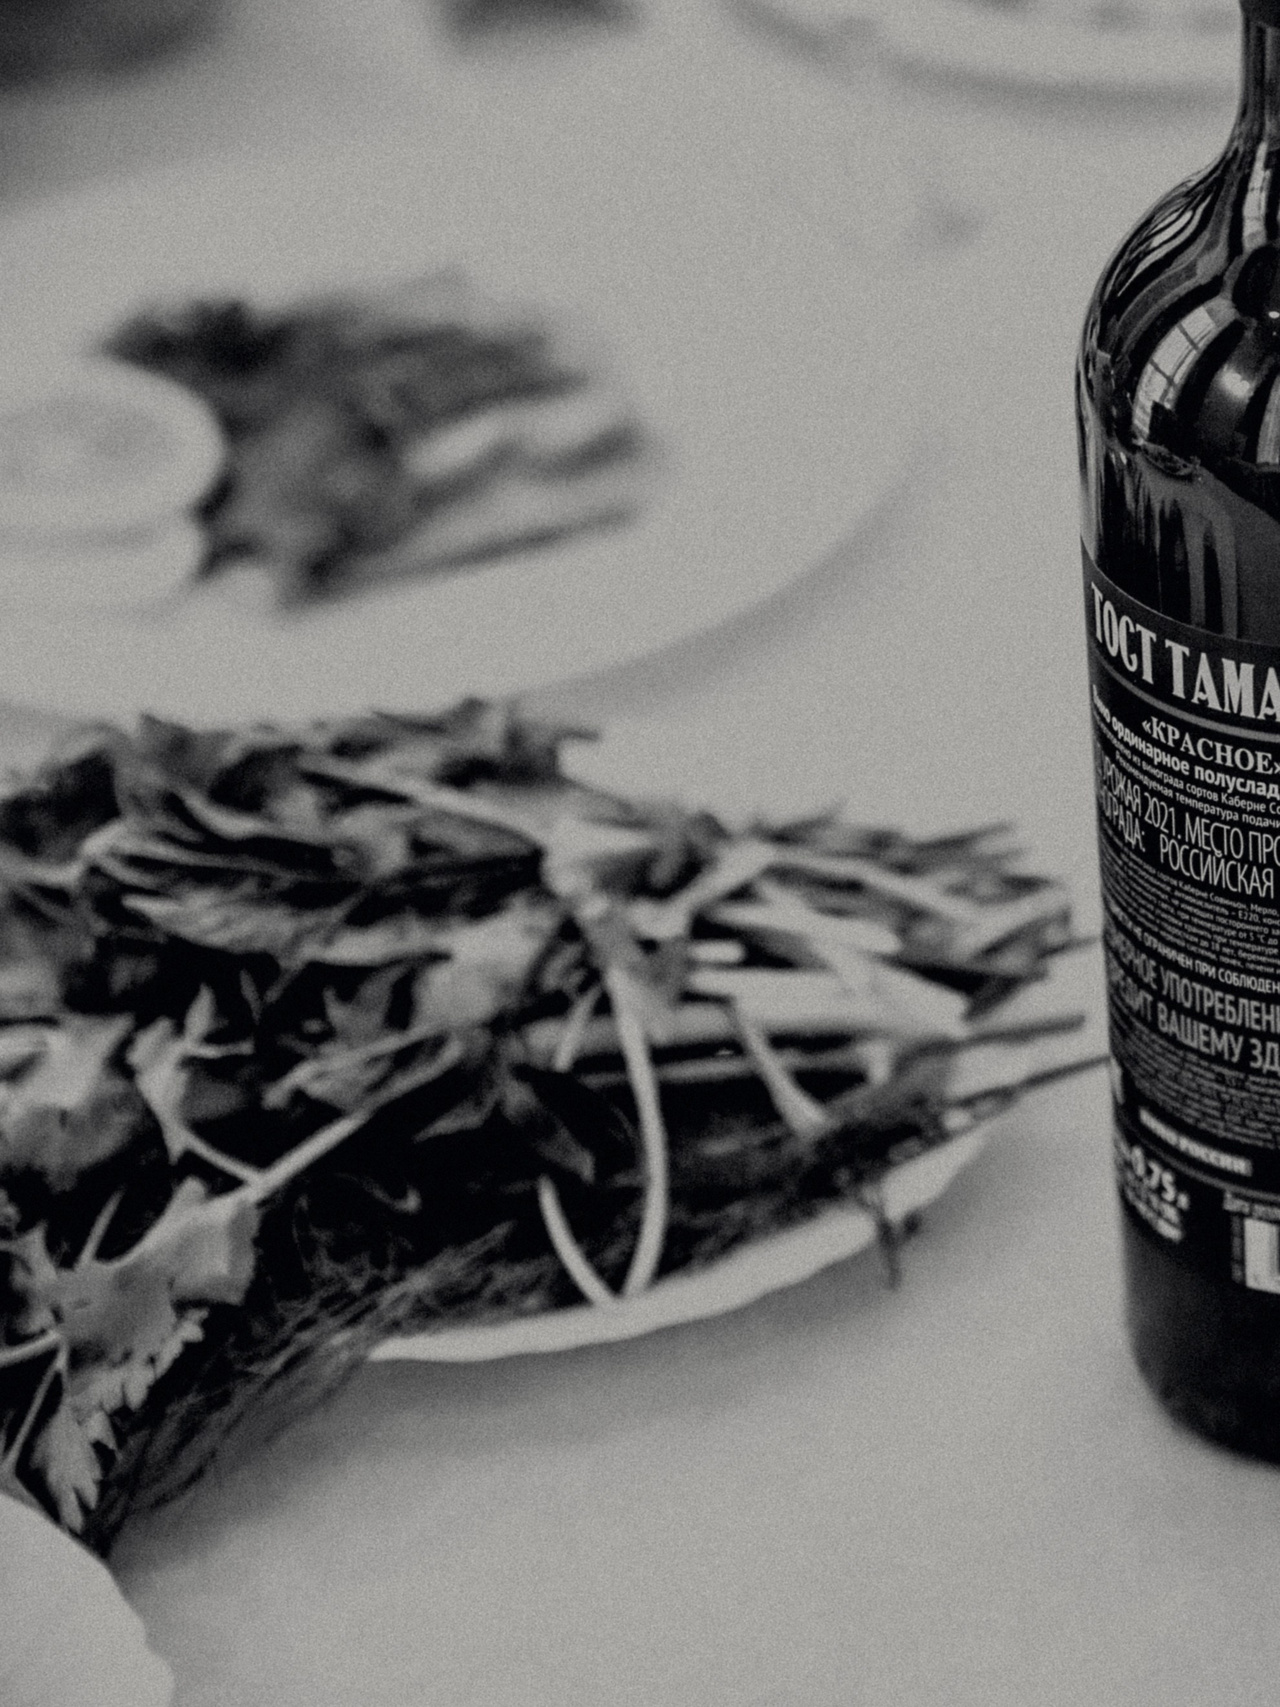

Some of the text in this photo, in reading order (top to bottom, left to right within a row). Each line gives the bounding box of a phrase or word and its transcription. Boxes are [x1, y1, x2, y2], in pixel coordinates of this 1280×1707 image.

[1091, 581, 1156, 685] ТОСТ
[1112, 716, 1190, 776] ординарное
[1144, 791, 1181, 839] 2021.
[1186, 811, 1244, 858] МЕСТО
[1175, 791, 1239, 822] температура
[1186, 782, 1219, 802] сортов
[1221, 793, 1267, 813] Каберне
[1159, 833, 1274, 899] РОССИЙСКАЯ
[1195, 960, 1217, 980] ПРИ
[1157, 1001, 1244, 1063] ВАШЕМУ
